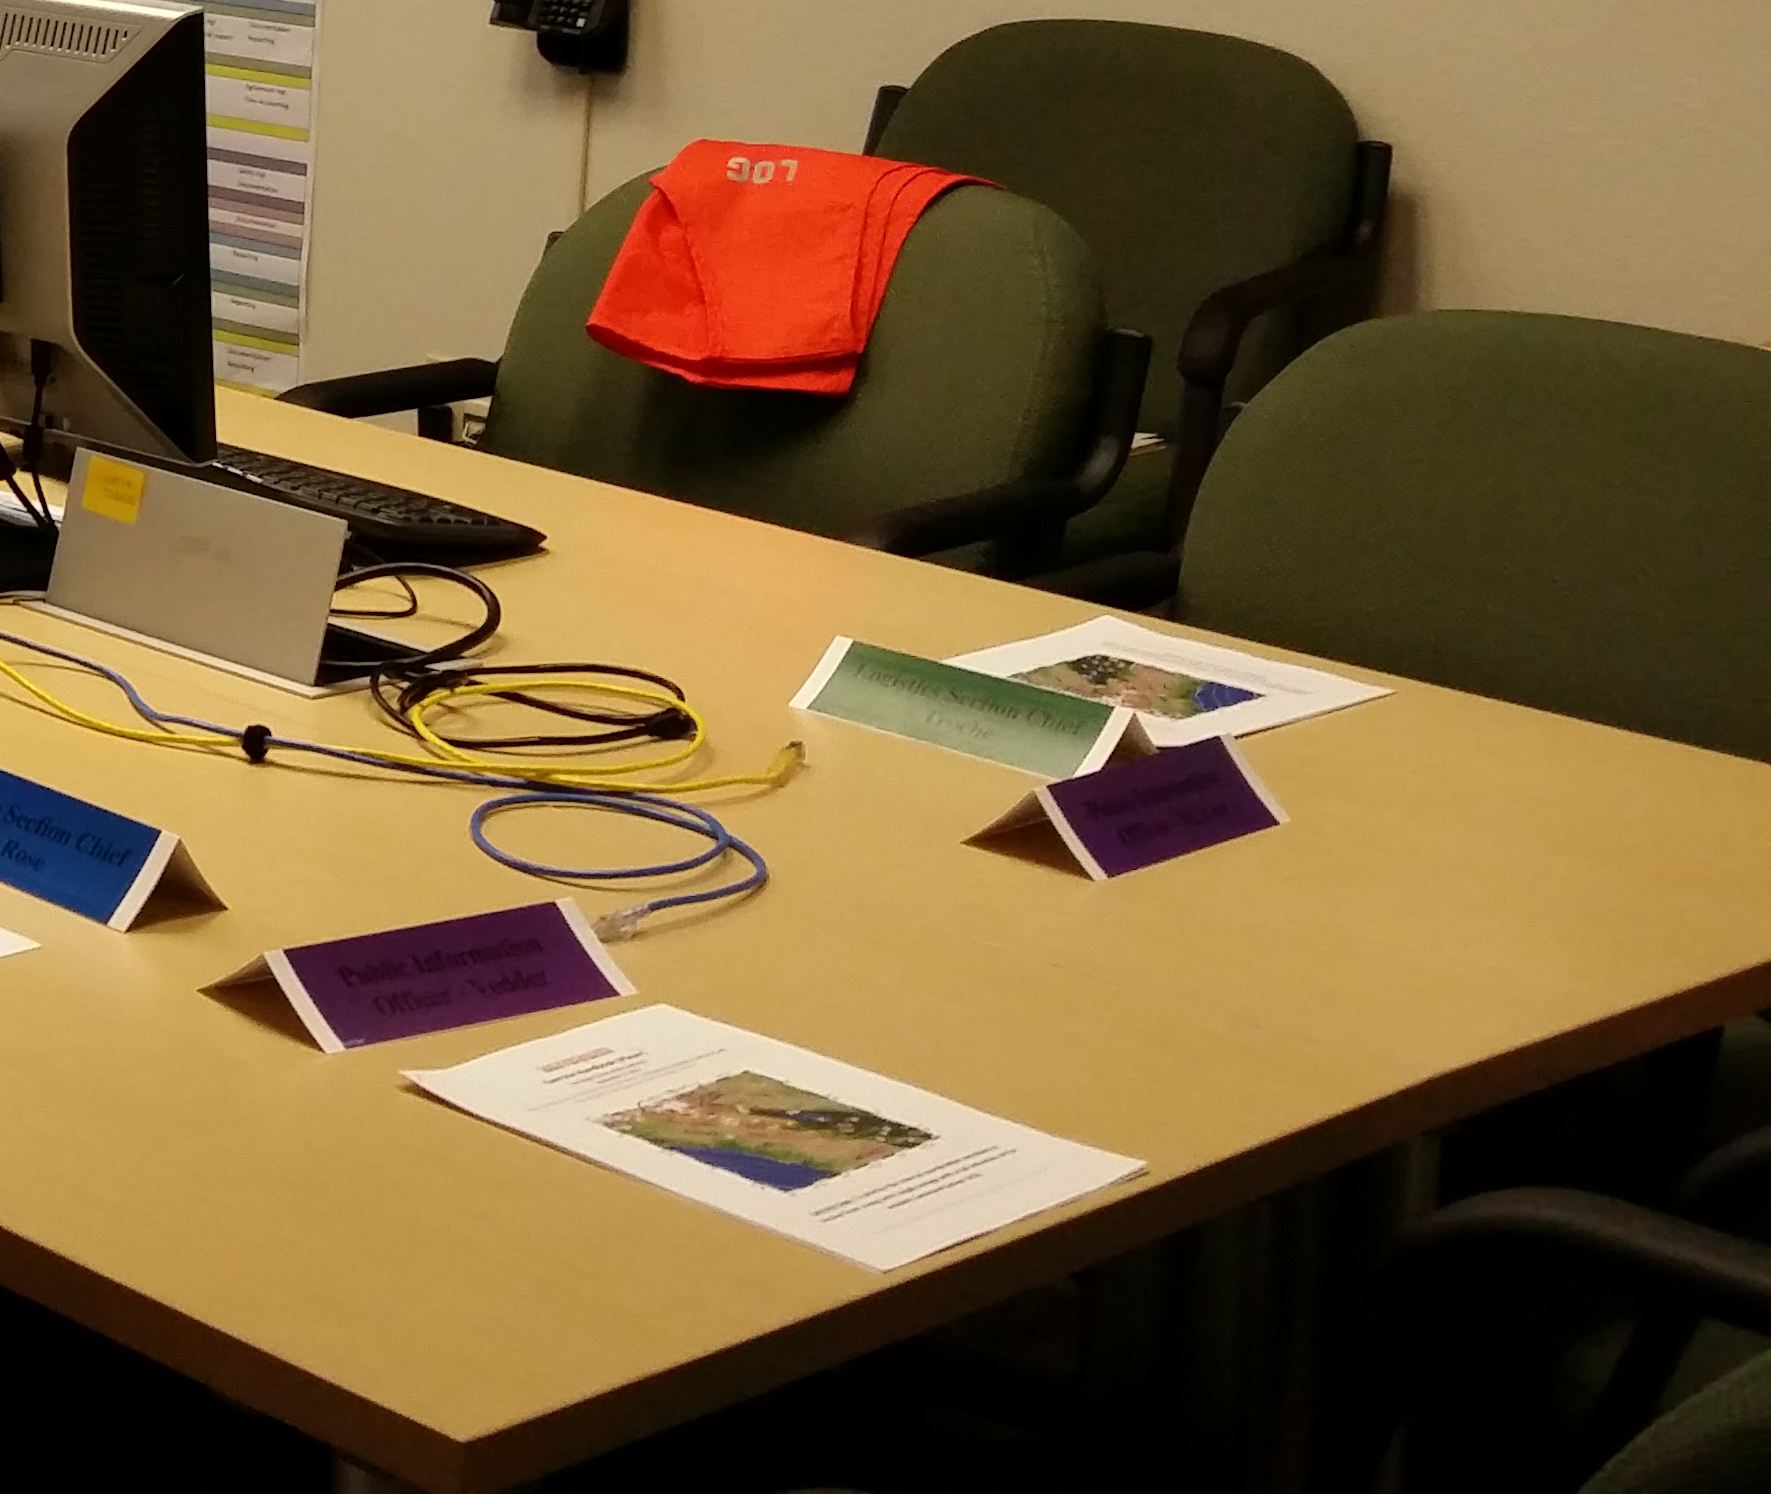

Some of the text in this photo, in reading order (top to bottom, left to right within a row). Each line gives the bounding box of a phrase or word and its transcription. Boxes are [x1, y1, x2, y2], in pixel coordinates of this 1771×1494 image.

[726, 156, 799, 185] LOG
[0, 837, 48, 872] Rose
[1, 805, 73, 847] Section
[75, 832, 135, 868] Chief
[337, 938, 545, 988] Public Information
